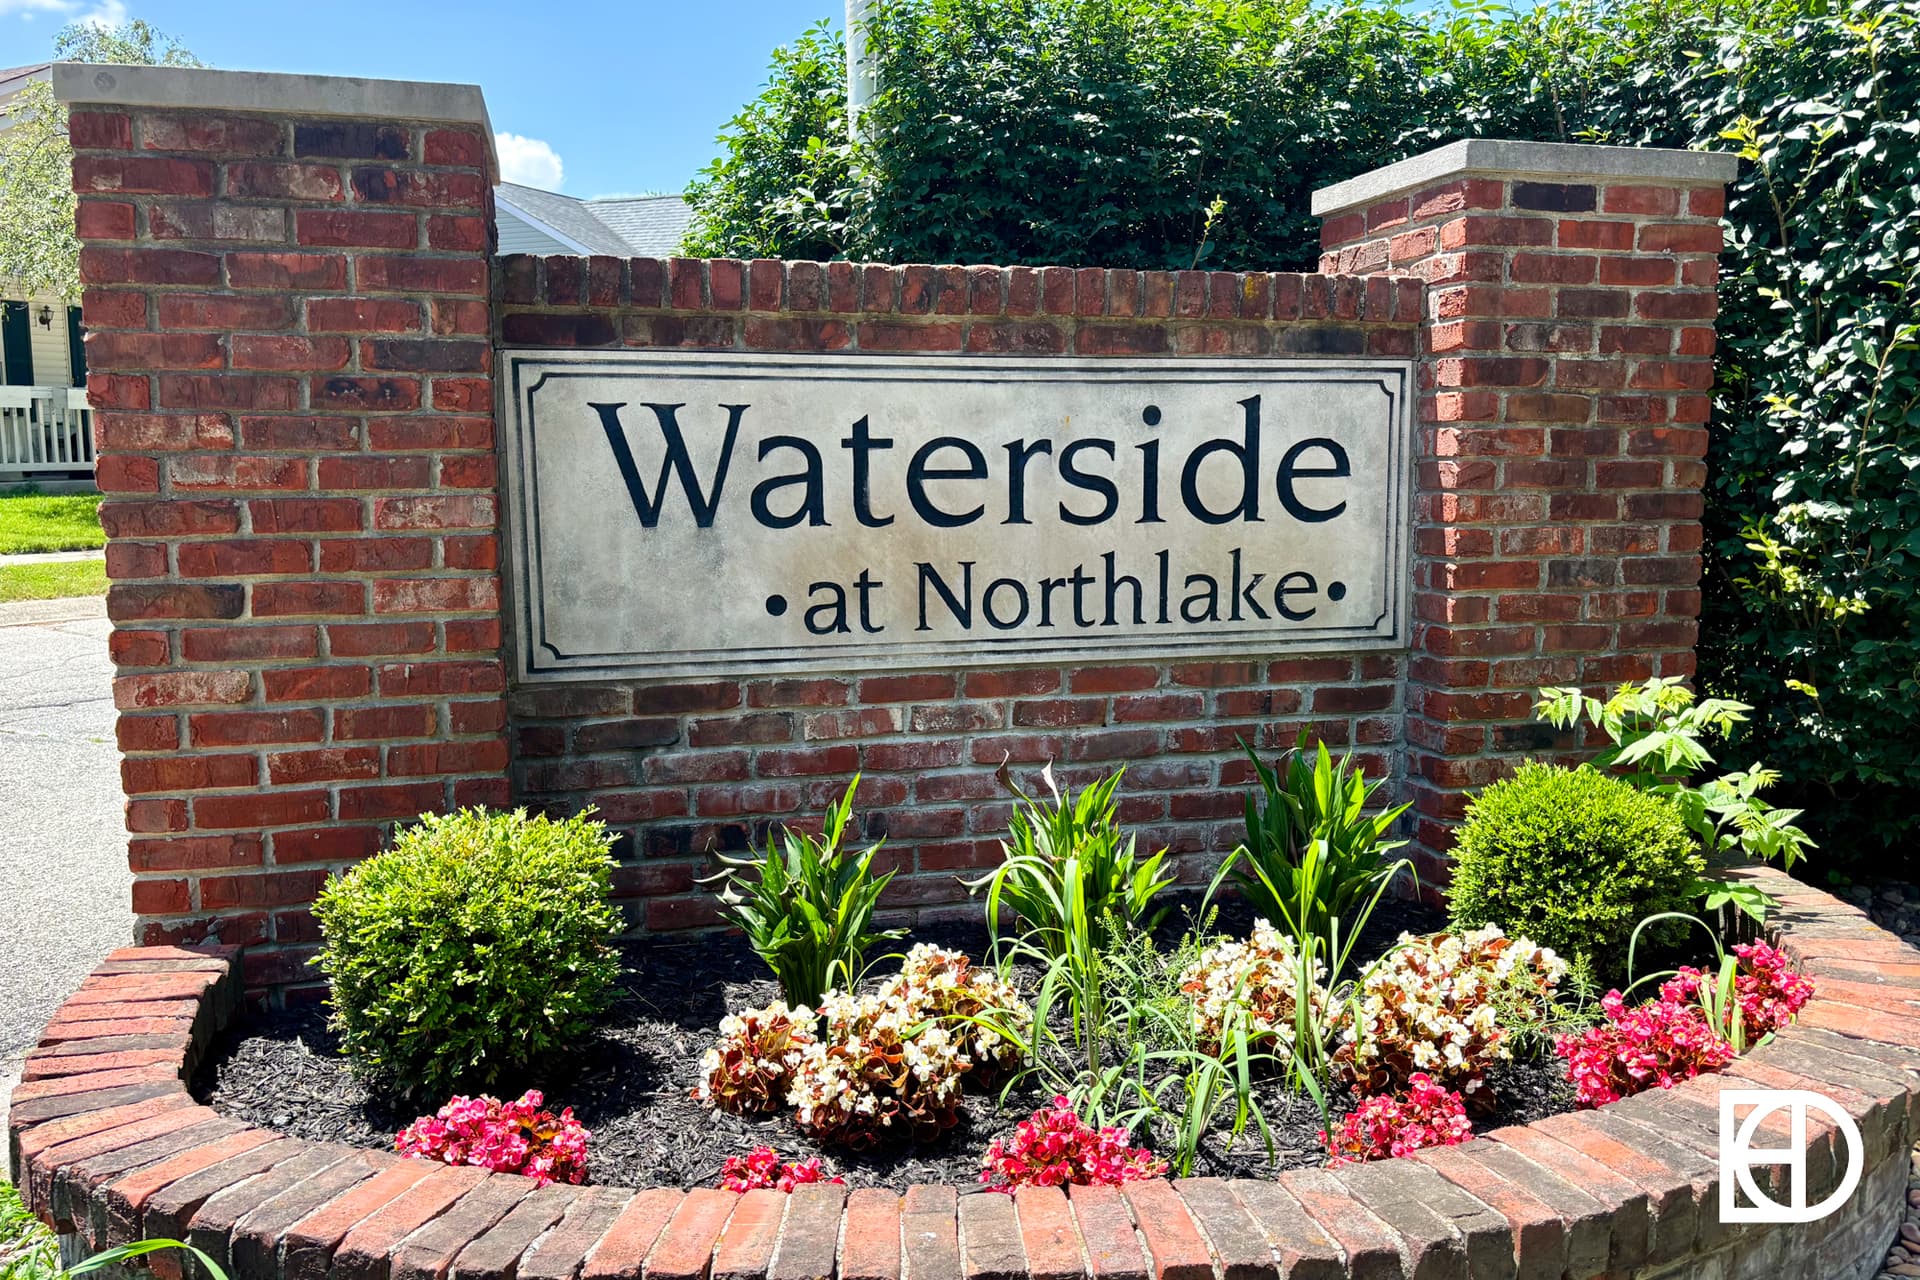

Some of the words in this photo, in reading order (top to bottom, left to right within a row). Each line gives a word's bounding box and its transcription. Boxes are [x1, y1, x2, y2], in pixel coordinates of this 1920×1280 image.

[587, 395, 1351, 529] Waterside
[804, 568, 884, 635] at
[913, 548, 1318, 632] Northlake
